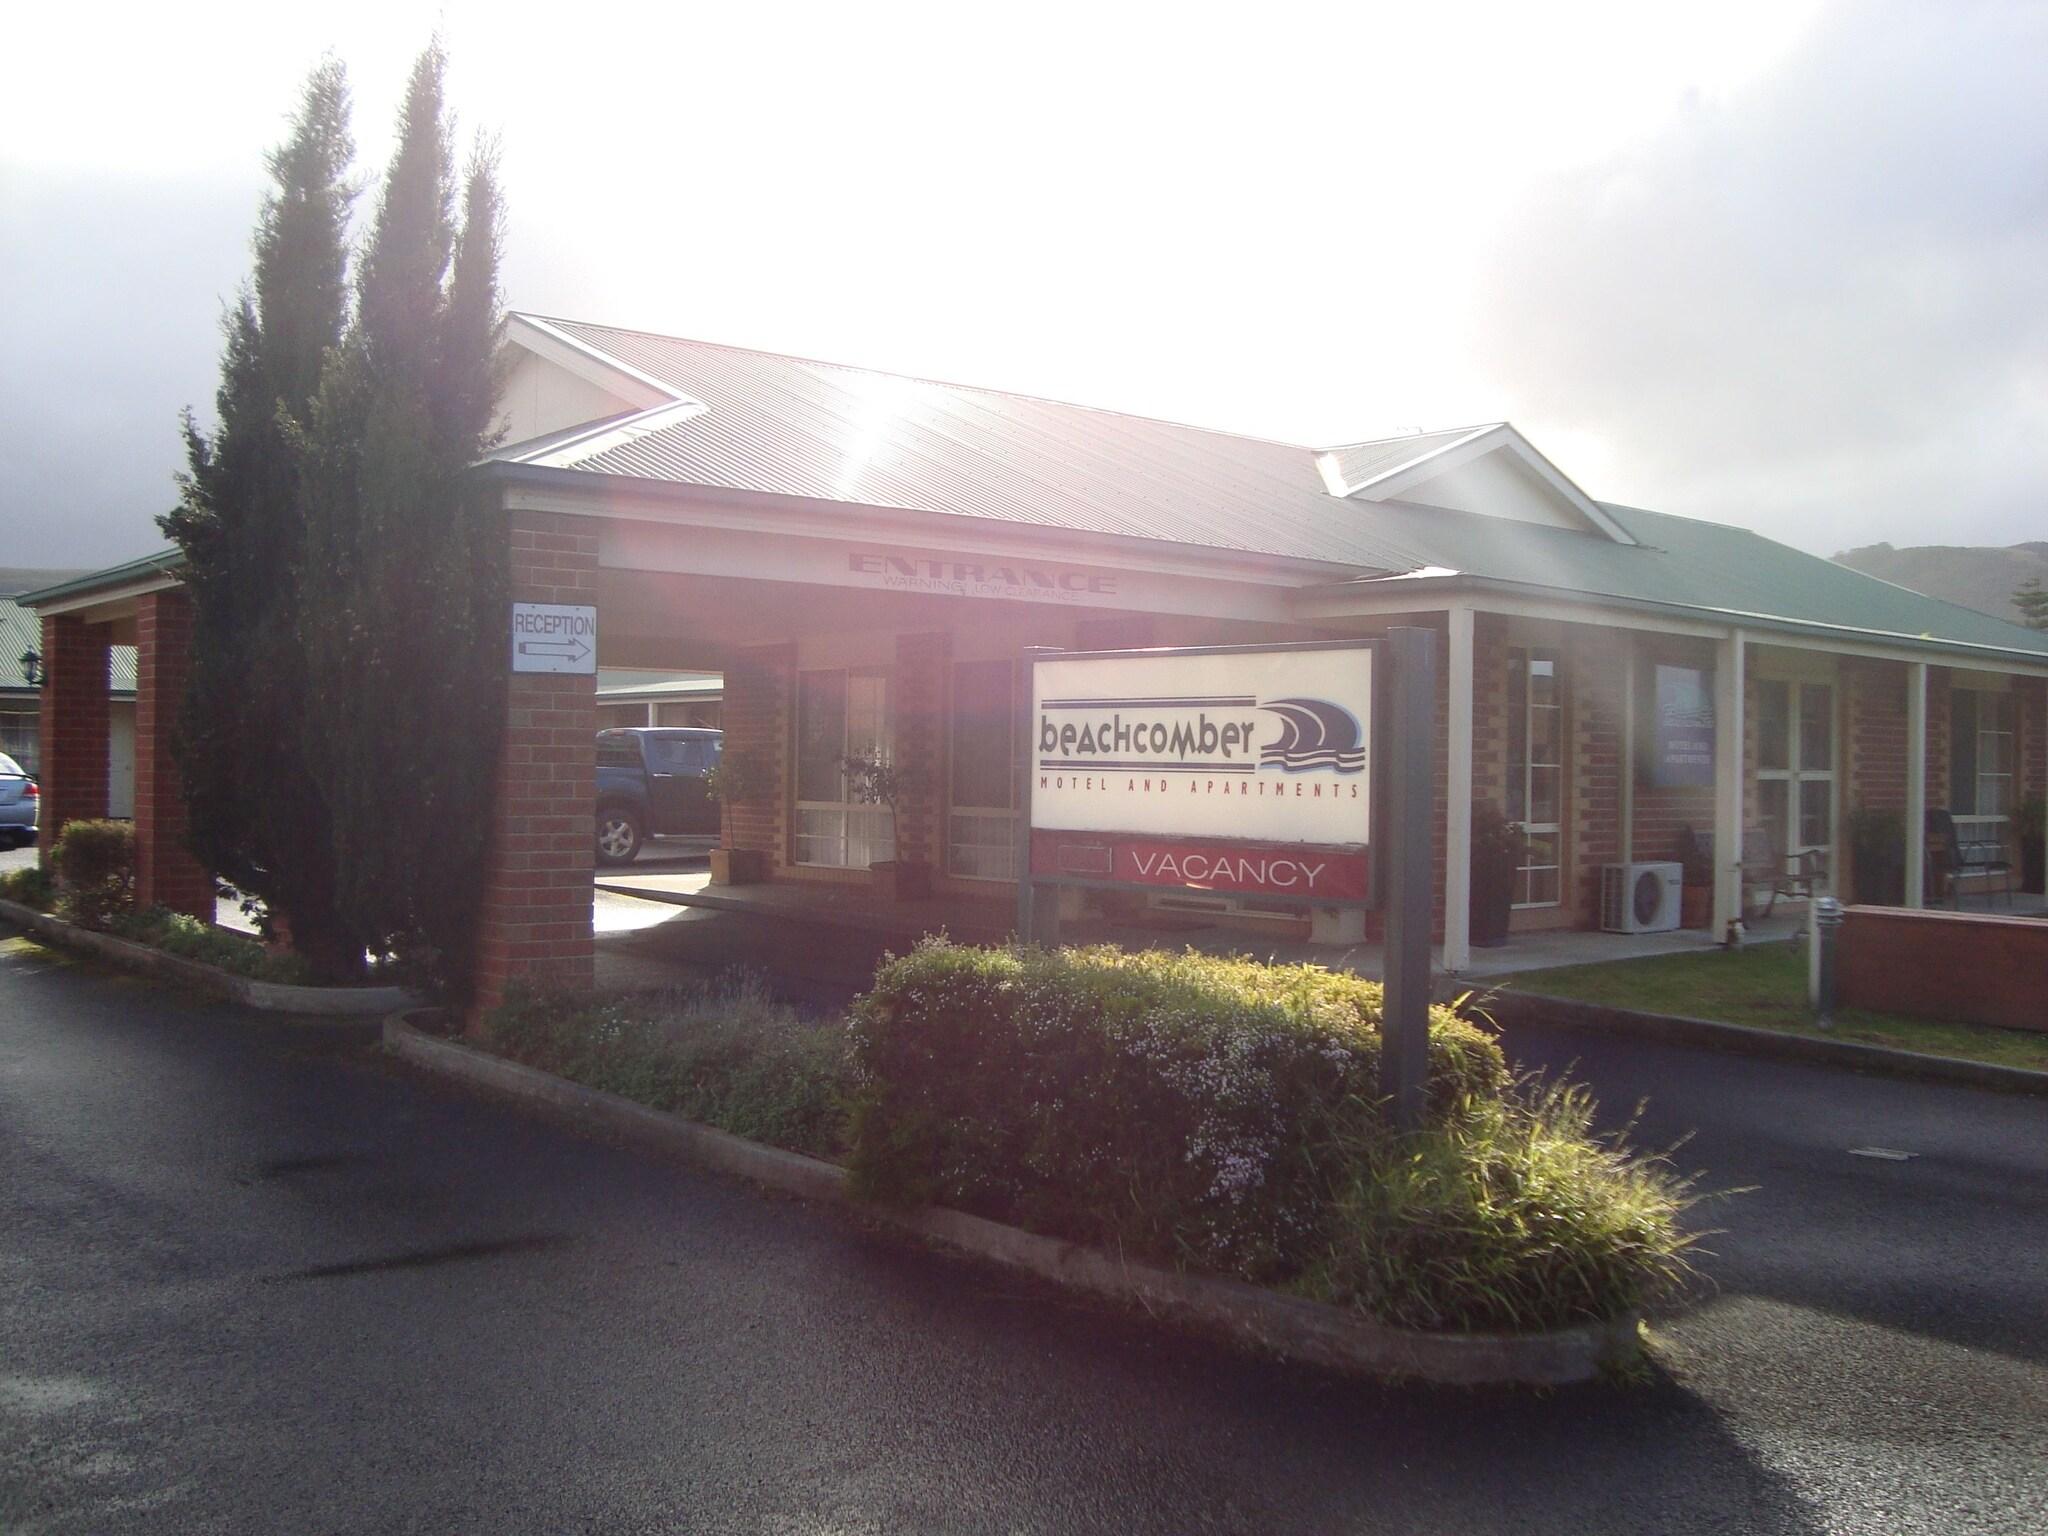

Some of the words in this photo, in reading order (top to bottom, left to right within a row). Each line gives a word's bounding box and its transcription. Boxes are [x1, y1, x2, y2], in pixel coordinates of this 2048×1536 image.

[849, 553, 1119, 595] ENTRANCE
[515, 613, 594, 635] RECEPTION
[1040, 776, 1106, 791] MOTEL
[1128, 779, 1168, 793] AND
[1190, 780, 1358, 798] APARTMENTS
[1132, 851, 1326, 888] VACANCY
